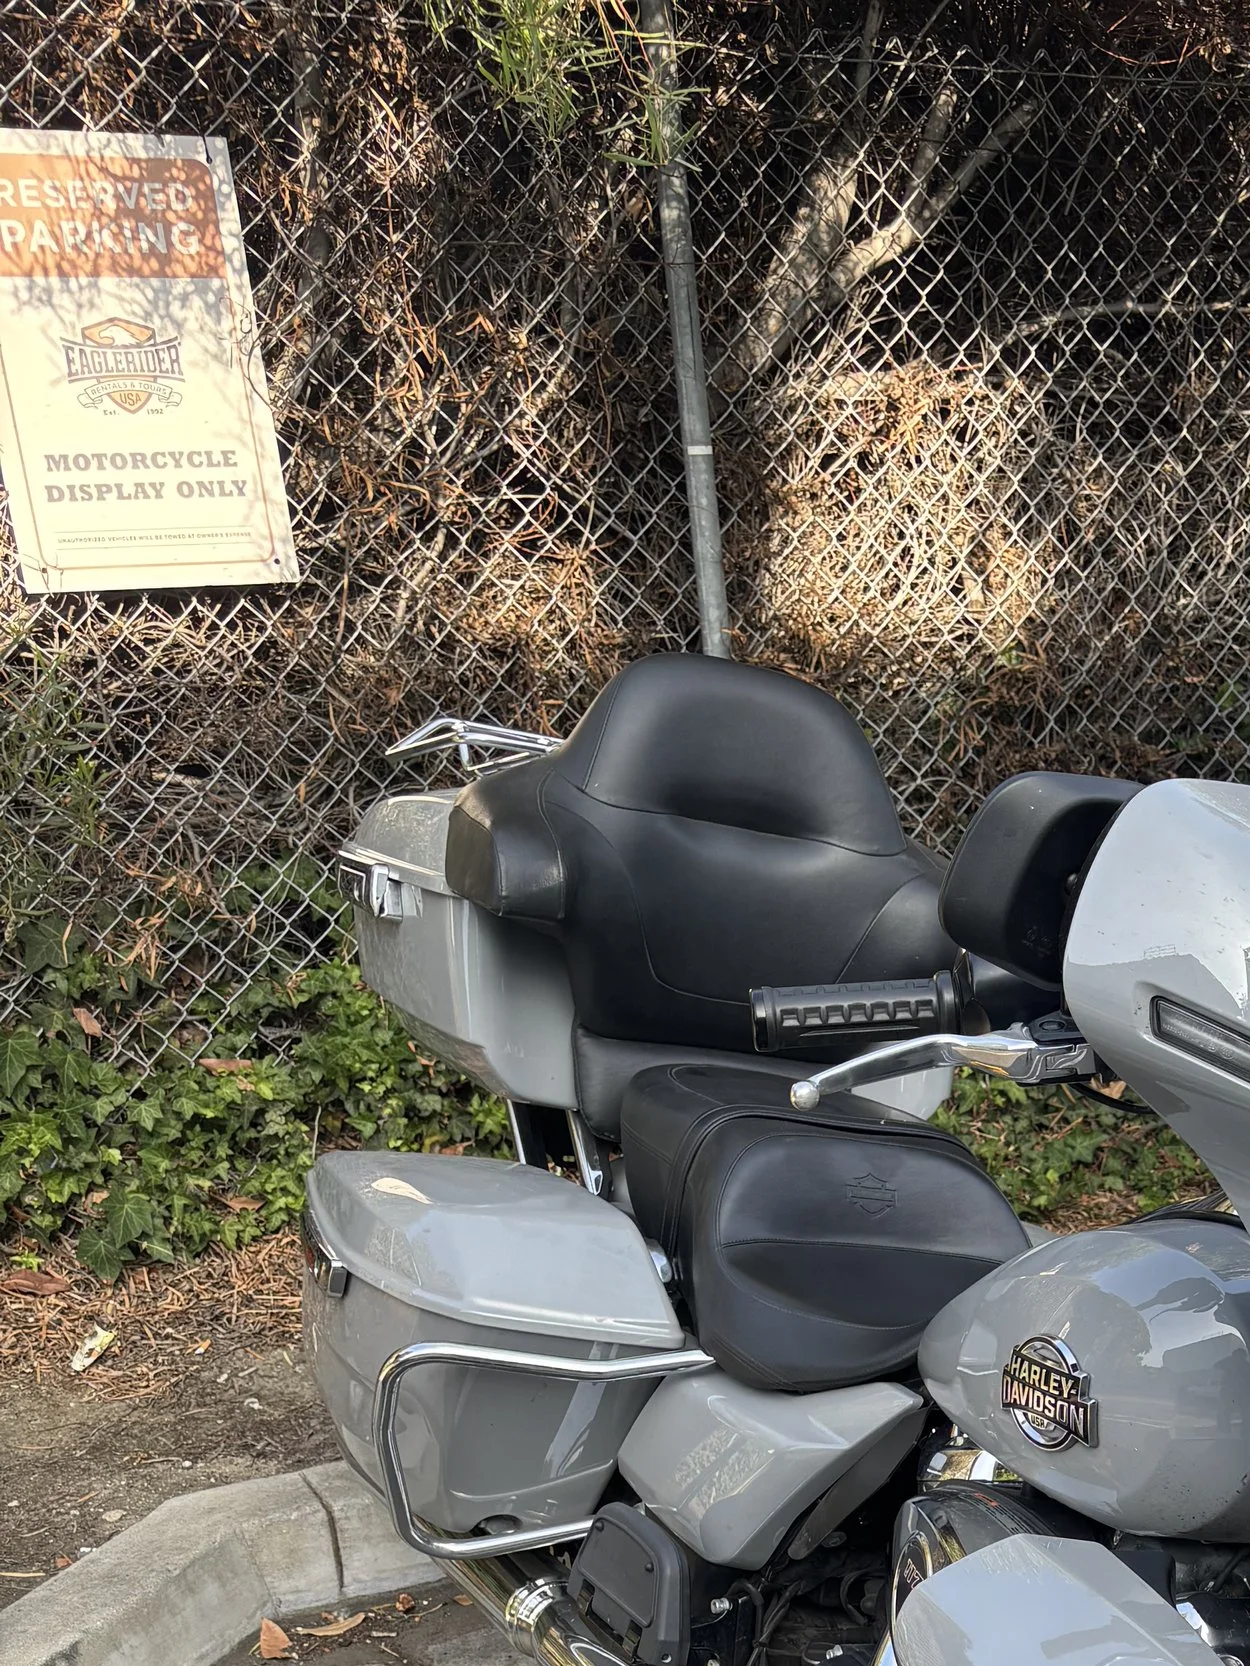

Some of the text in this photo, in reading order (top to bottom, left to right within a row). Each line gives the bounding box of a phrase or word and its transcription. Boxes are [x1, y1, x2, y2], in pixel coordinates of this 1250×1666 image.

[0, 177, 193, 211] RESERVED
[0, 218, 201, 255] PARKING
[62, 343, 184, 378] EAGLERIDER
[91, 381, 128, 396] RENTALS
[139, 382, 167, 396] TOURS
[119, 392, 142, 406] USA
[44, 450, 238, 472] MOTORCYCLE
[44, 480, 248, 503] DISPLAY ONLY
[1003, 1375, 1085, 1438] DAVIDSON
[1030, 1414, 1046, 1429] USA
